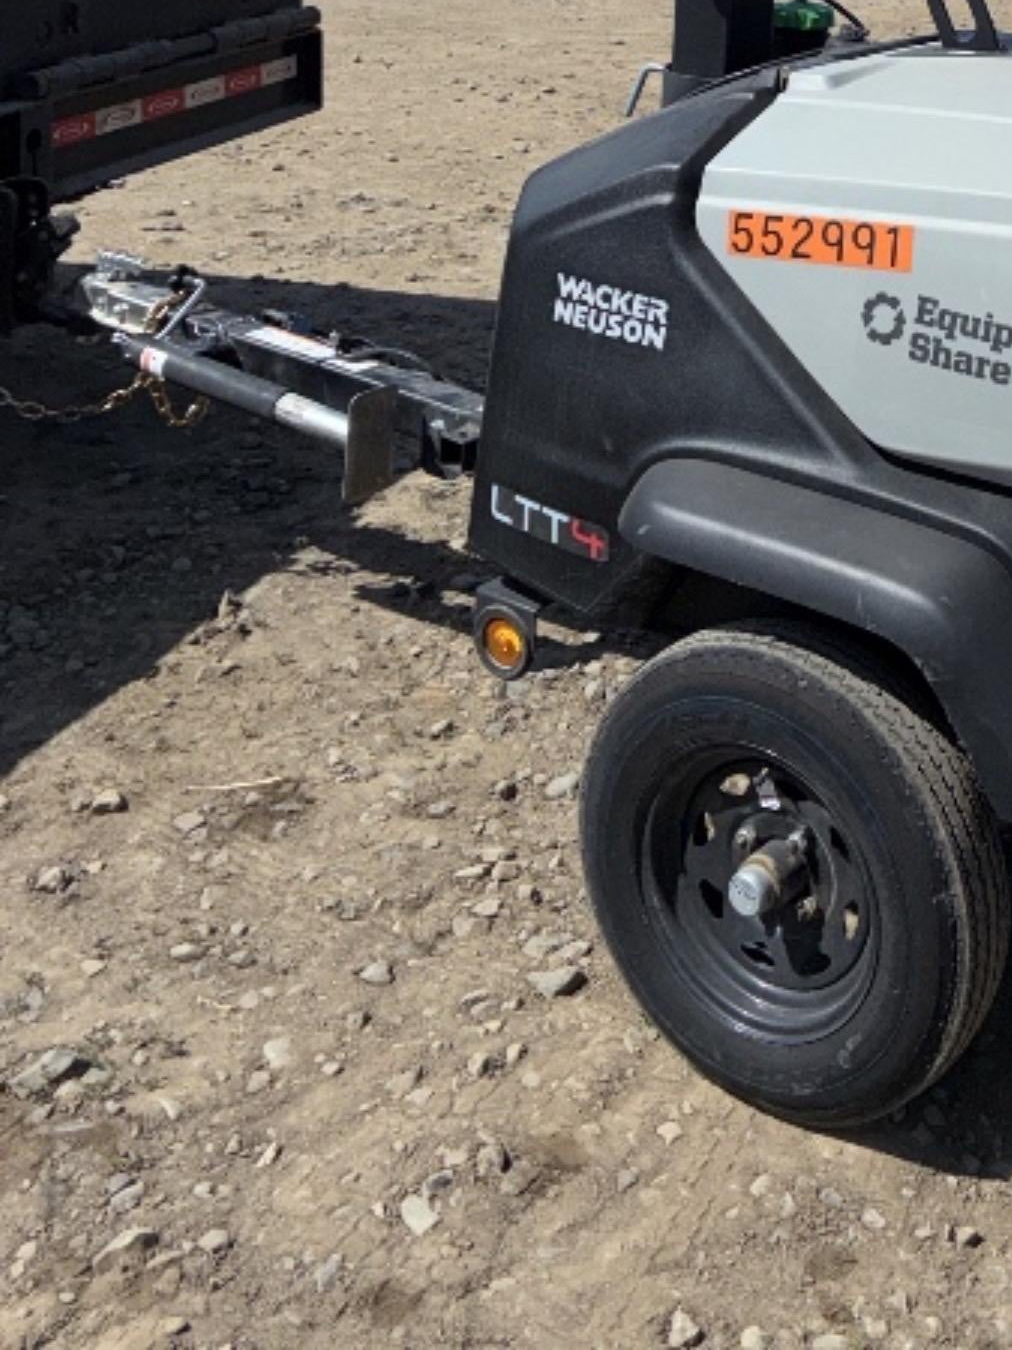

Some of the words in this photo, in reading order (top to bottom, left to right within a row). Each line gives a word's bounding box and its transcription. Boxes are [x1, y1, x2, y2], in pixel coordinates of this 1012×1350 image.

[730, 211, 899, 268] 552991
[553, 300, 667, 350] NEUSON
[557, 272, 670, 325] WACKER
[908, 333, 1012, 386] Share
[490, 483, 606, 561] LTT4
